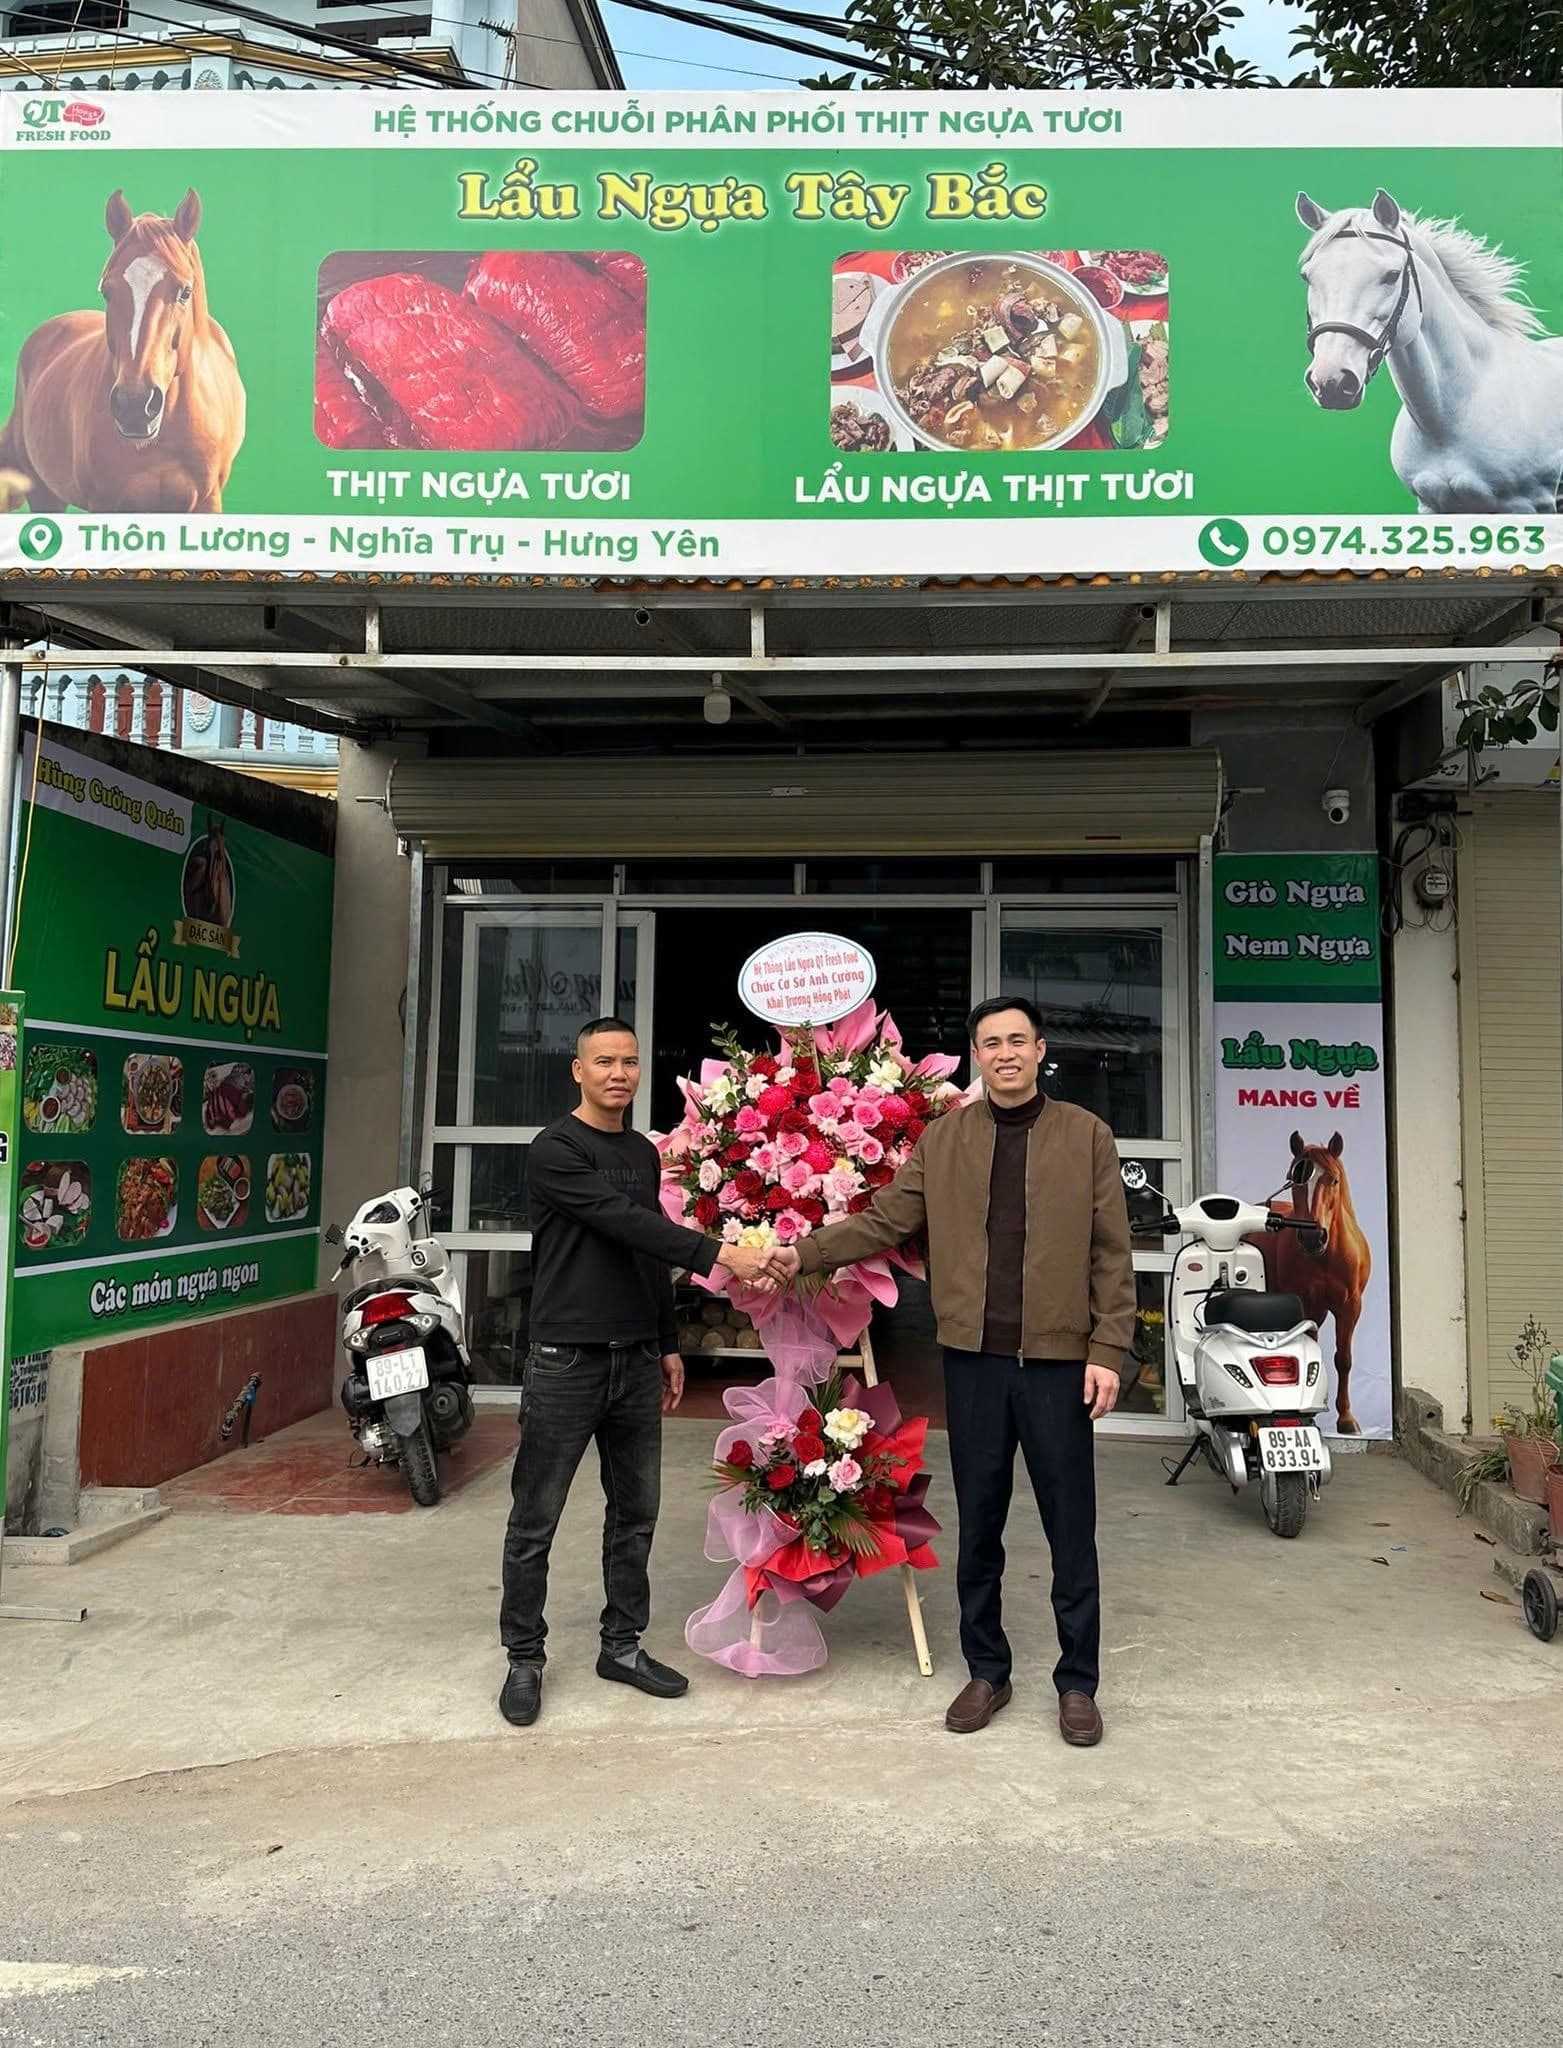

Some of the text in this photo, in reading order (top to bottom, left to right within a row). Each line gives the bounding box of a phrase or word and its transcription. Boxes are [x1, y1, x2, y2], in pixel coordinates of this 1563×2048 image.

[23, 99, 66, 128] QT
[374, 99, 1123, 139] HỆ THỐNG CHUỖI PHÂN PHỐI THỊT NGỰA TƯƠI
[16, 130, 112, 142] FRESH FOOD
[458, 158, 1047, 232] Lẩu Ngựa Tây Bắc
[327, 468, 631, 508] THỊT NGỰA TƯƠI
[795, 460, 1194, 510] LẨU NGỰA THỊT TƯƠI
[78, 524, 165, 553] Thôn
[179, 525, 290, 559] Lương
[329, 526, 434, 561] Nghĩa
[447, 527, 504, 562] Trụ
[543, 529, 637, 563] Hưng
[651, 530, 720, 558] Yên
[1262, 525, 1546, 556] 0974.325.963
[38, 757, 184, 835] Hùng Cường Quán
[1225, 880, 1366, 909] Giò Ngựa
[825, 952, 842, 967] Fresh
[843, 950, 859, 964] Food
[1225, 934, 1371, 961] Nem Ngựa
[104, 927, 281, 1038] LẨU NGỰA
[750, 979, 776, 994] Chúc
[809, 972, 830, 986] Anh
[1221, 1030, 1379, 1077] Lẩu Ngựa
[1238, 1083, 1360, 1108] MANG VỀ
[89, 1262, 260, 1314] Các món ngựa ngon
[1268, 1429, 1312, 1448] 89-AA
[1266, 1448, 1321, 1468] 833.94
